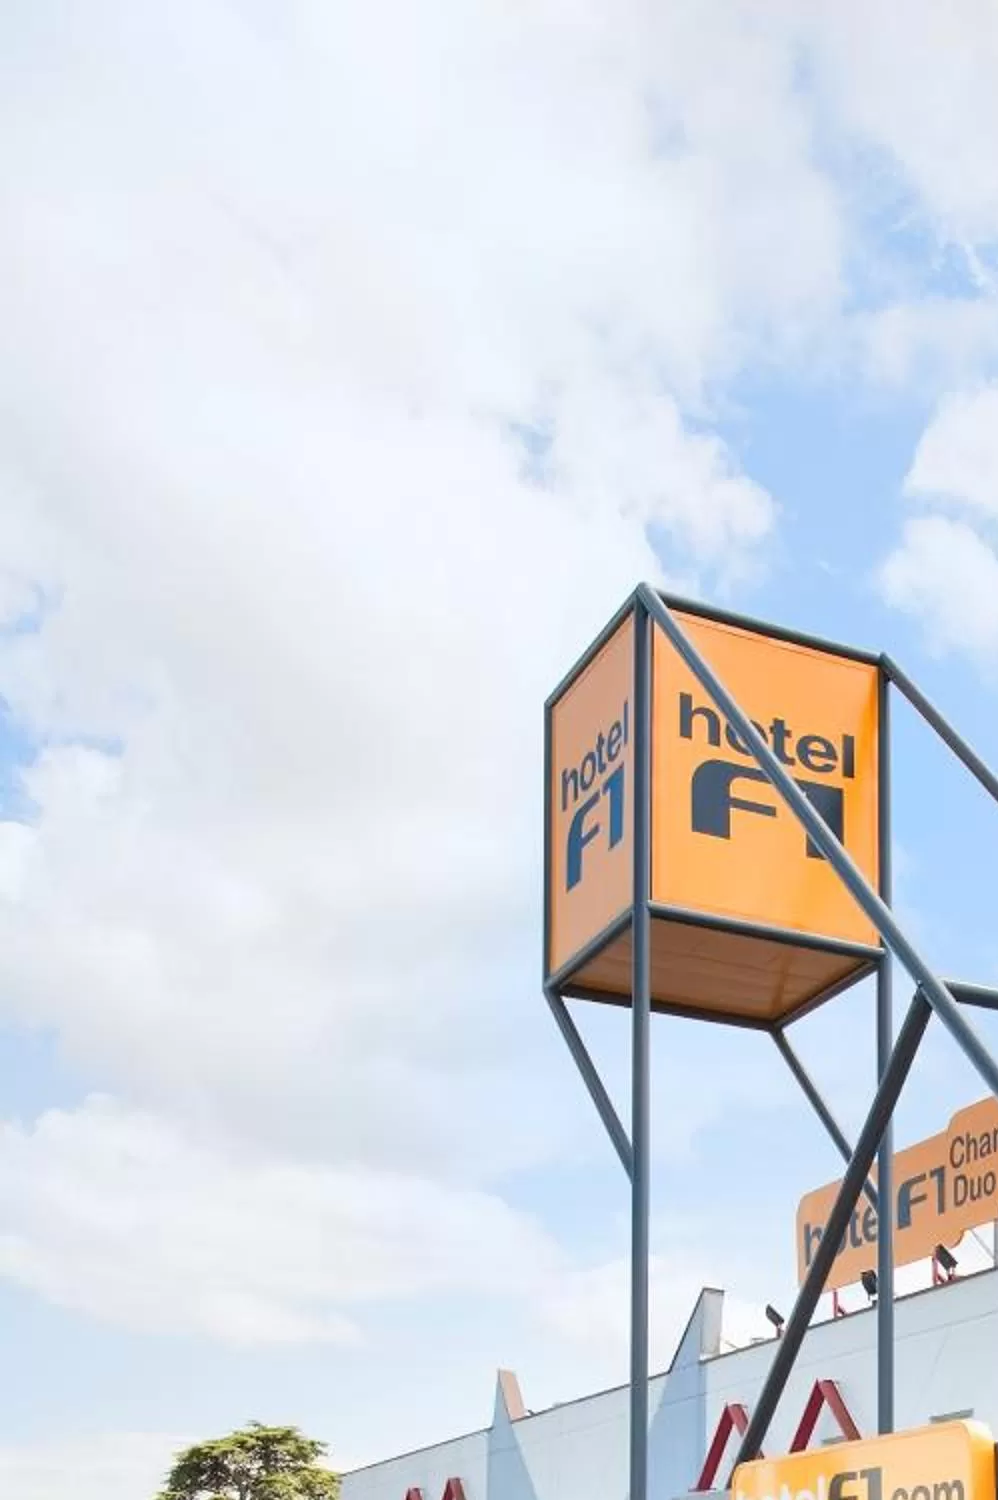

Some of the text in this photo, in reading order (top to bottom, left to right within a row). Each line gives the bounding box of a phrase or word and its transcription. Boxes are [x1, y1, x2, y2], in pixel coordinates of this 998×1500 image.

[561, 697, 629, 812] hotel
[566, 762, 625, 893] F1
[691, 759, 844, 860] F1
[803, 1165, 946, 1268] hte F1
[954, 1170, 996, 1207] Duo
